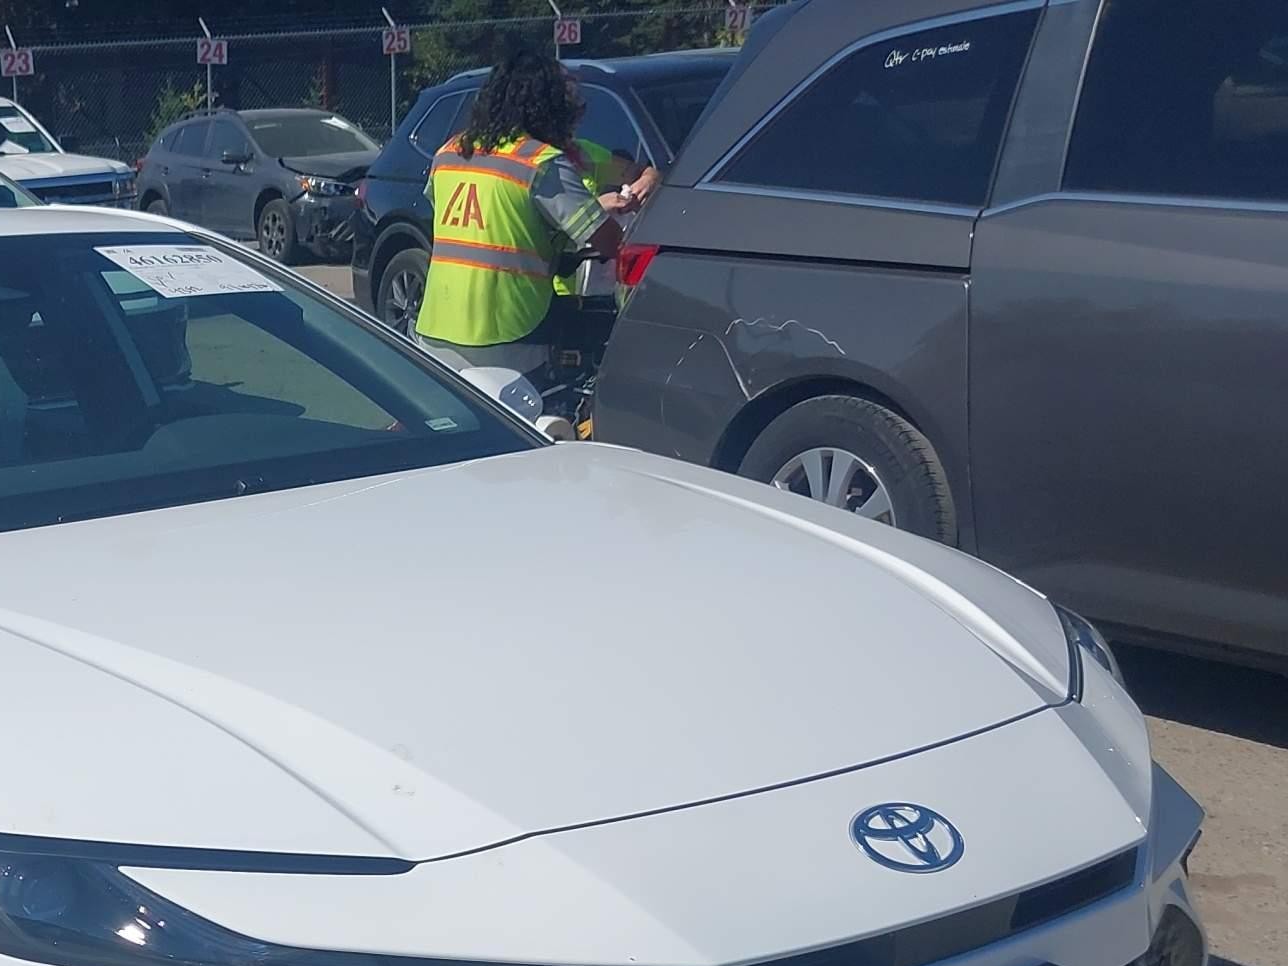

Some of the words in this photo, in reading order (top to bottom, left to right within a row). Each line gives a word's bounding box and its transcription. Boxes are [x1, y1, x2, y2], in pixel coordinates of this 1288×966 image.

[728, 10, 747, 30] 27
[385, 30, 408, 53] 25
[556, 22, 578, 44] 26
[2, 52, 31, 74] 23
[199, 40, 224, 64] 24
[128, 254, 225, 268] 46162850
